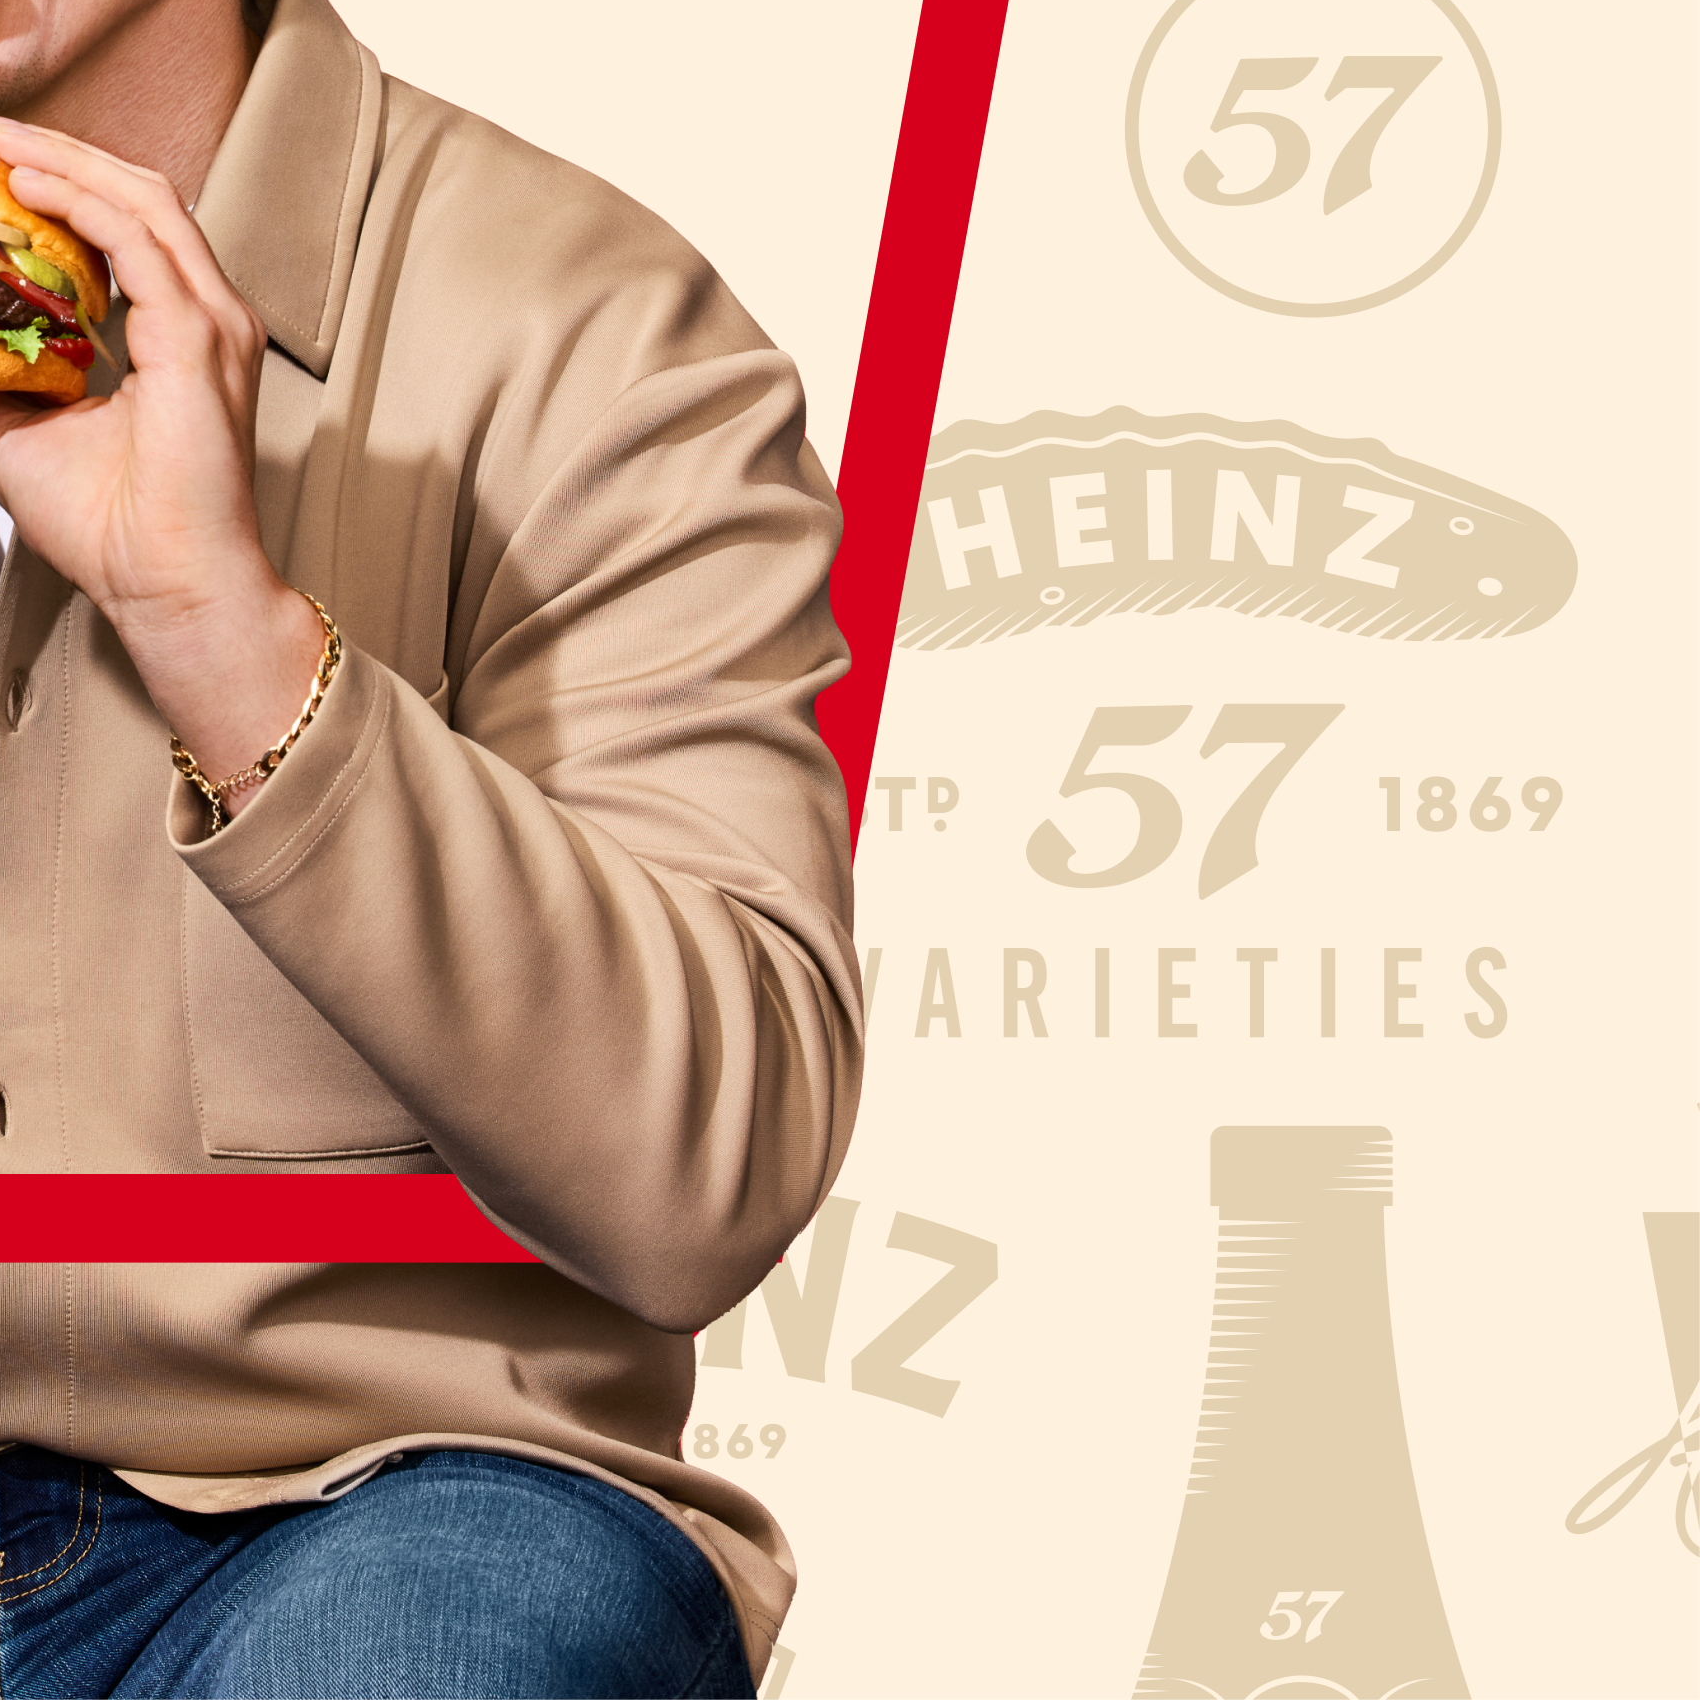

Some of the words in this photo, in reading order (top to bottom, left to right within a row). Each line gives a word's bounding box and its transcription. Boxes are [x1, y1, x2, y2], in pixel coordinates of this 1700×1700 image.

[1184, 56, 1443, 215] 57
[927, 470, 1415, 590] HEINZ
[1026, 704, 1345, 900] 57
[1380, 777, 1563, 832] 1869
[693, 1423, 787, 1459] 869
[1260, 1591, 1344, 1643] 57
